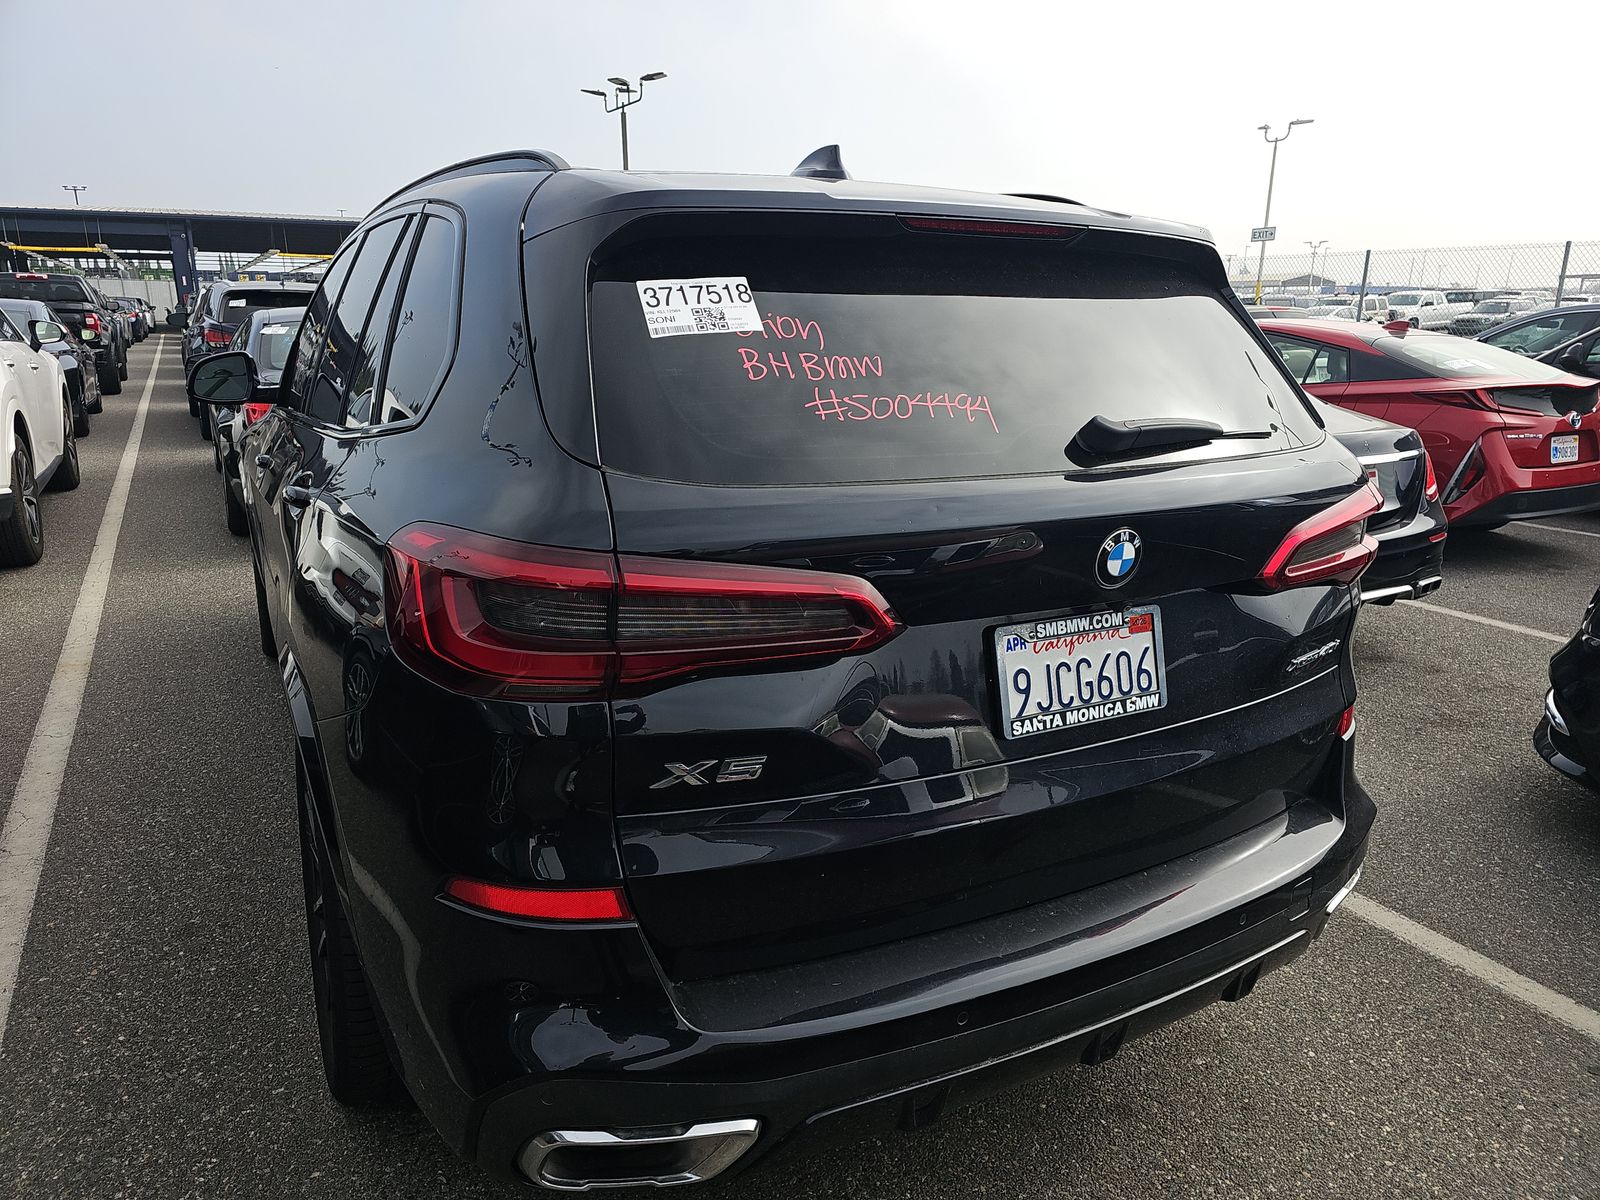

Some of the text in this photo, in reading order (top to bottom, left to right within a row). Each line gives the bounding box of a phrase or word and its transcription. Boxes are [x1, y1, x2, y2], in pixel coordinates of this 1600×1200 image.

[1253, 230, 1269, 239] EXIT
[643, 283, 752, 308] 3717518
[648, 315, 676, 325] SONI
[736, 313, 825, 350] rion
[738, 347, 796, 381] BH
[1104, 531, 1141, 552] BMW
[1036, 612, 1123, 639] SMBMW.COM
[1006, 637, 1028, 652] APR
[1013, 645, 1153, 718] 9JCG606
[1012, 694, 1160, 735] SANTA MONICA BMW
[648, 755, 768, 789] X5
